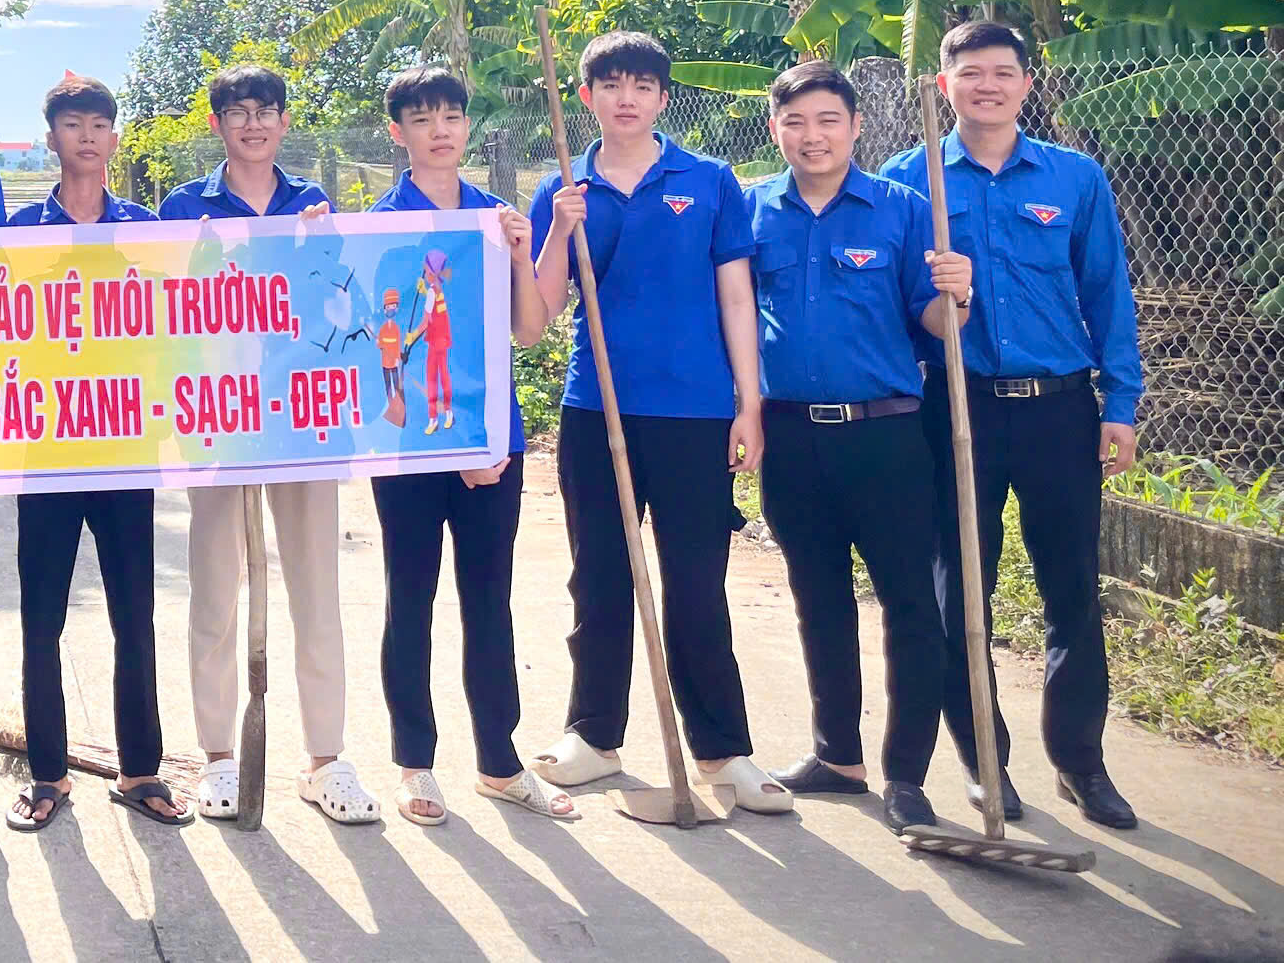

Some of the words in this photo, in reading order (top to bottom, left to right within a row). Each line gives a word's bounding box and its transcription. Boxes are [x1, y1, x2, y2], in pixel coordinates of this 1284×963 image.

[43, 269, 83, 353] VỆ
[92, 267, 155, 338] MÔI
[163, 261, 300, 340] TRƯỜNG,
[53, 377, 143, 439] XANH
[152, 403, 164, 417] -
[174, 373, 262, 448] SẠCH
[270, 399, 282, 413] -
[290, 367, 362, 442] ĐẸP!
